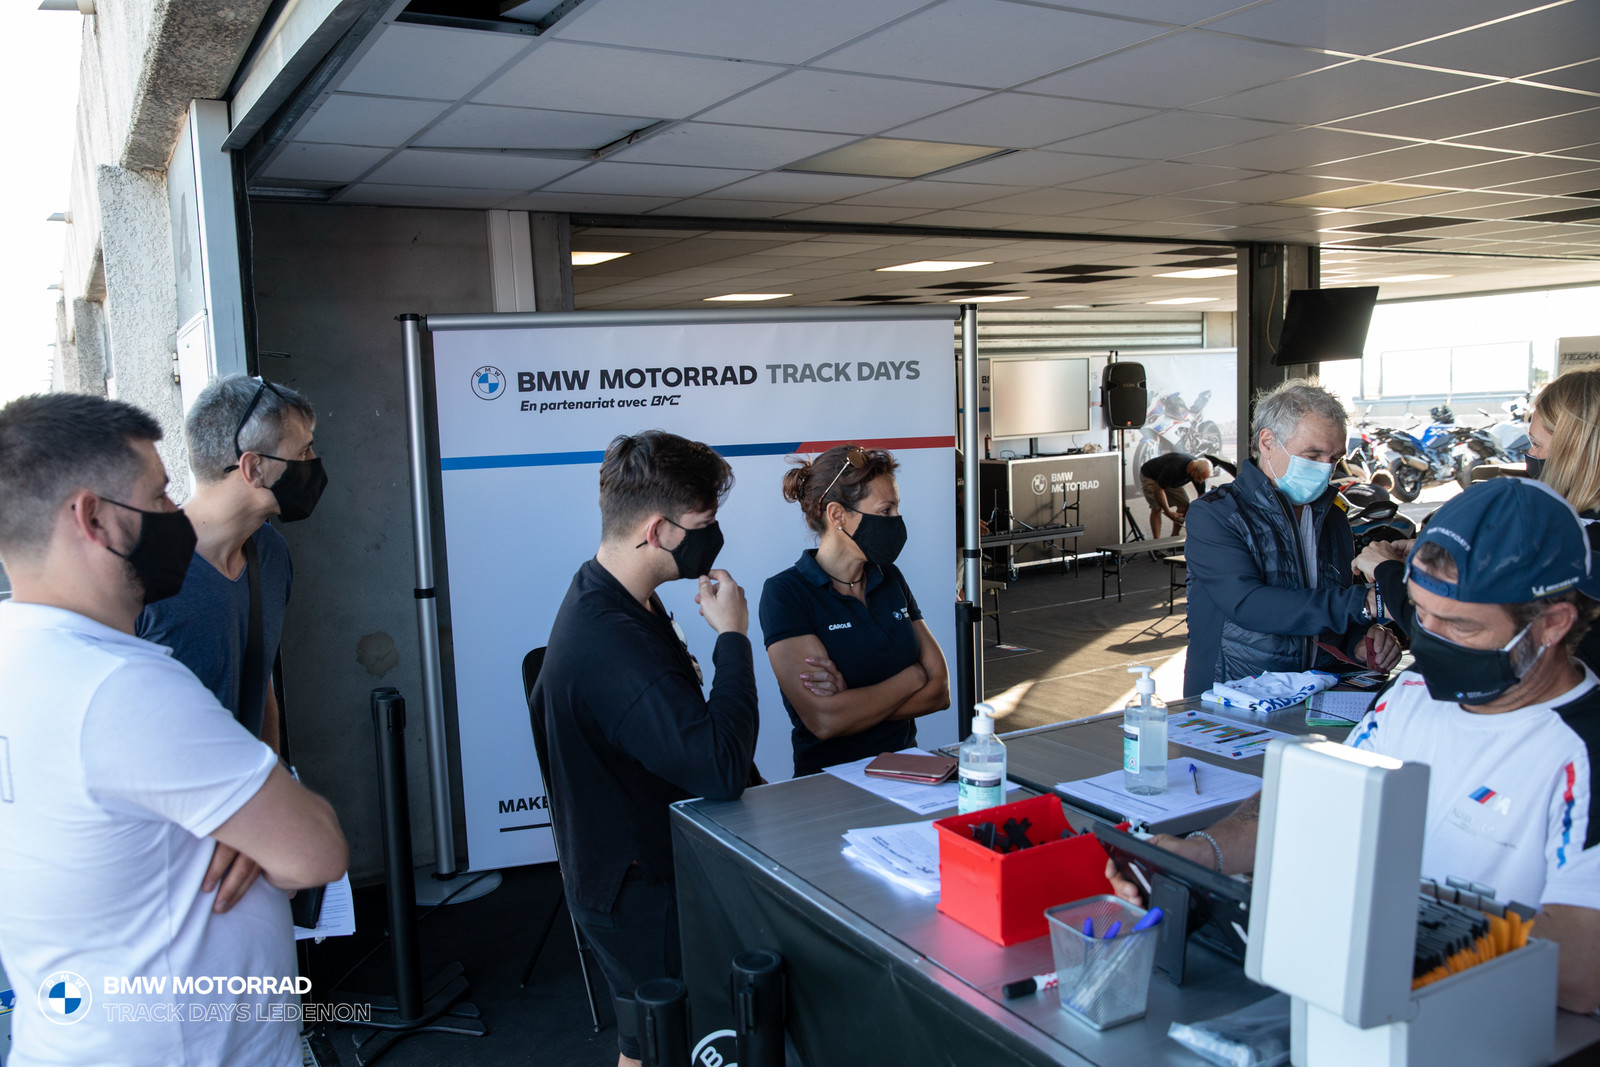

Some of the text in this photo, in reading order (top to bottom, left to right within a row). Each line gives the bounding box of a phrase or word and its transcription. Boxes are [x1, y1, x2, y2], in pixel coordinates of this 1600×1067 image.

[517, 360, 921, 392] BMW MOTORRAD TRACK DAYS
[520, 394, 682, 413] En partenariat avec BMC
[1051, 472, 1073, 482] BMW
[828, 622, 852, 631] CAROLE
